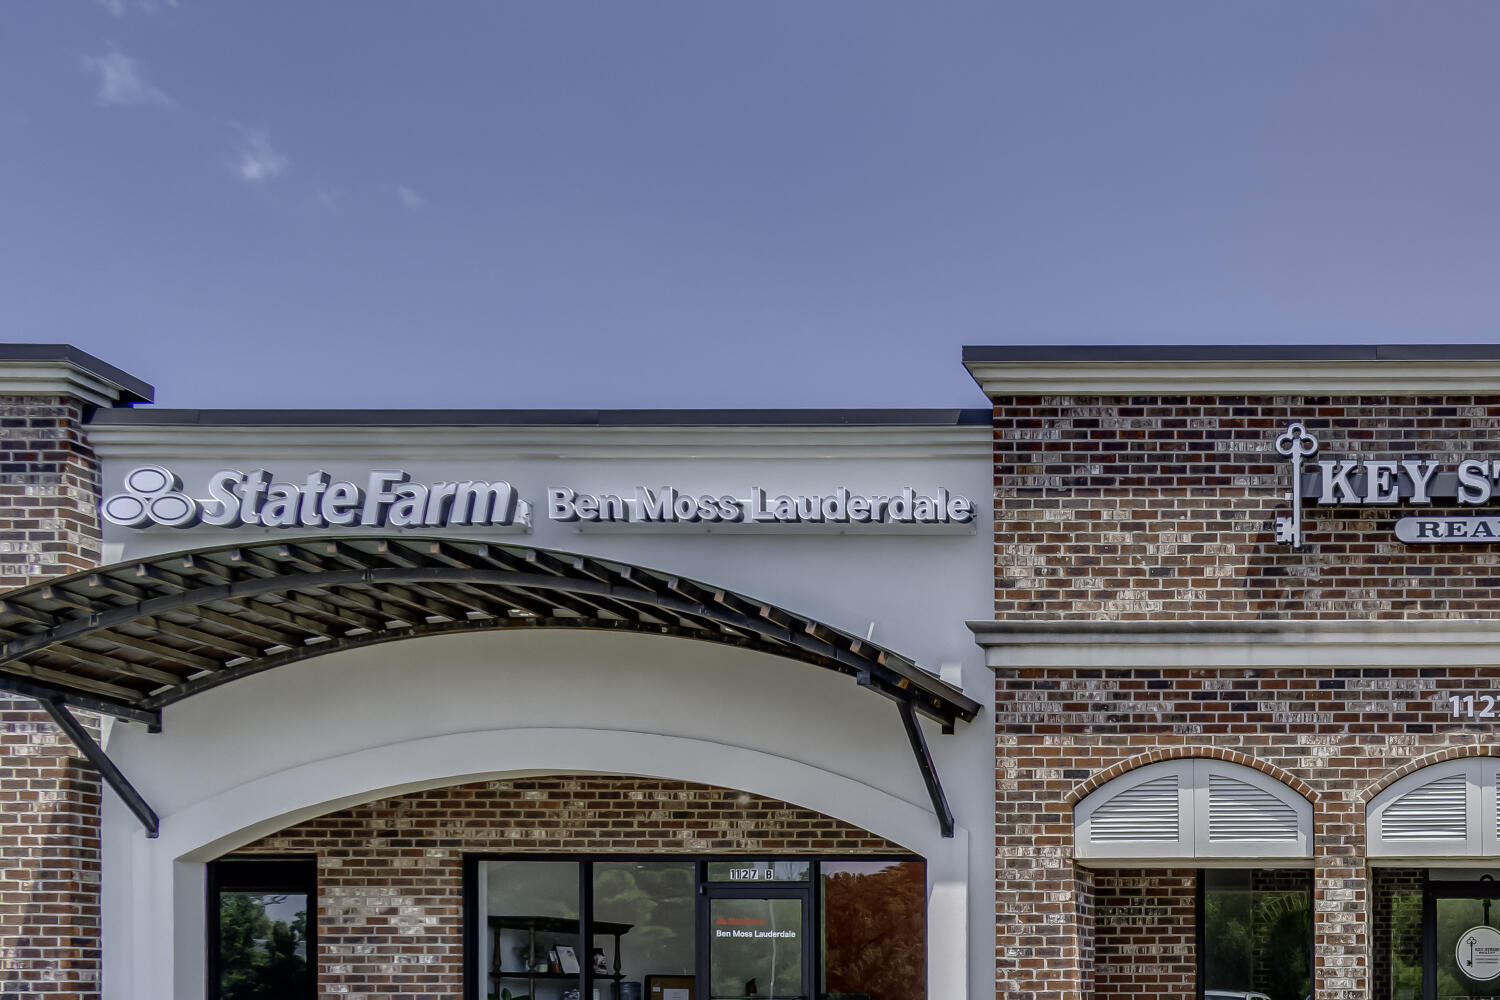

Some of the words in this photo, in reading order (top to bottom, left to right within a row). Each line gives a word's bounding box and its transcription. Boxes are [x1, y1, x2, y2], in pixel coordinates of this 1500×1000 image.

[1318, 459, 1441, 504] KEY
[548, 486, 628, 523] Ben
[635, 486, 744, 523] Moss
[751, 486, 976, 524] Lauderdale
[730, 869, 758, 880] 1127
[765, 869, 774, 880] B
[716, 929, 731, 938] Ben
[732, 929, 753, 938] Moss
[754, 929, 796, 938] Lauderdale
